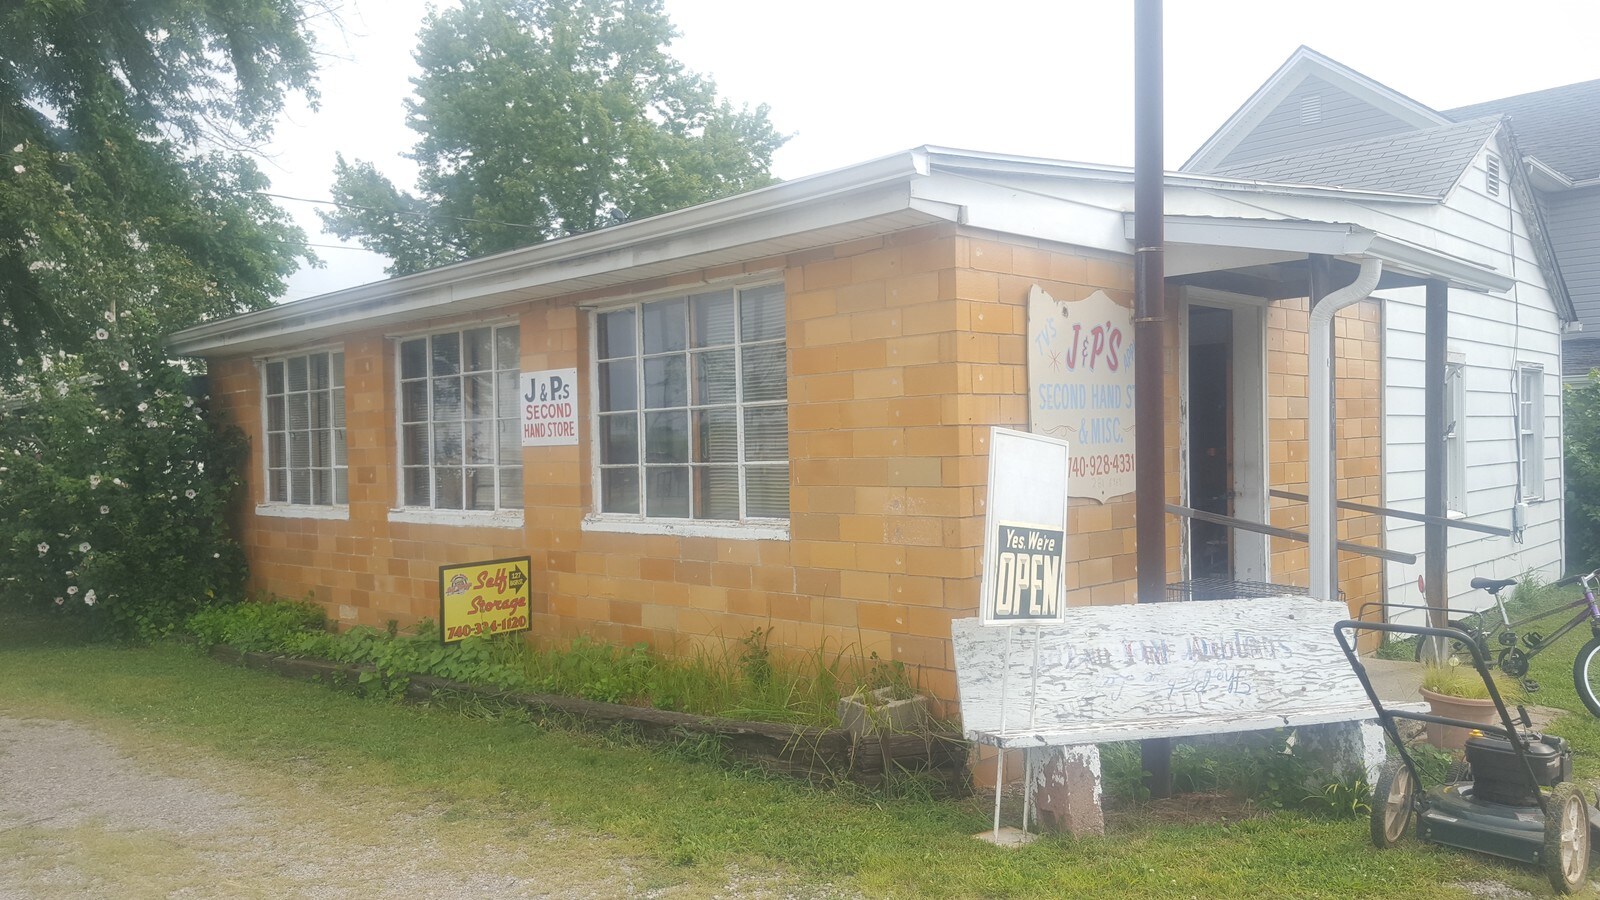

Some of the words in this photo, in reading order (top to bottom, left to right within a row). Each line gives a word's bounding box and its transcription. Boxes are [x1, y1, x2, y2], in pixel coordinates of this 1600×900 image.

[1066, 324, 1082, 371] J
[1082, 336, 1091, 368] &
[1089, 320, 1123, 372] P'S
[524, 378, 536, 403] J
[540, 383, 548, 402] &
[1038, 383, 1087, 411] SECOND
[1091, 384, 1123, 410] HAND
[526, 403, 572, 420] SECOND
[524, 423, 546, 438] HAND
[547, 421, 575, 437] STORE
[1078, 419, 1089, 445] &
[1091, 417, 1124, 444] MISC.
[473, 567, 508, 595] Self
[996, 552, 1060, 616] OPEN
[467, 595, 527, 616] Storage
